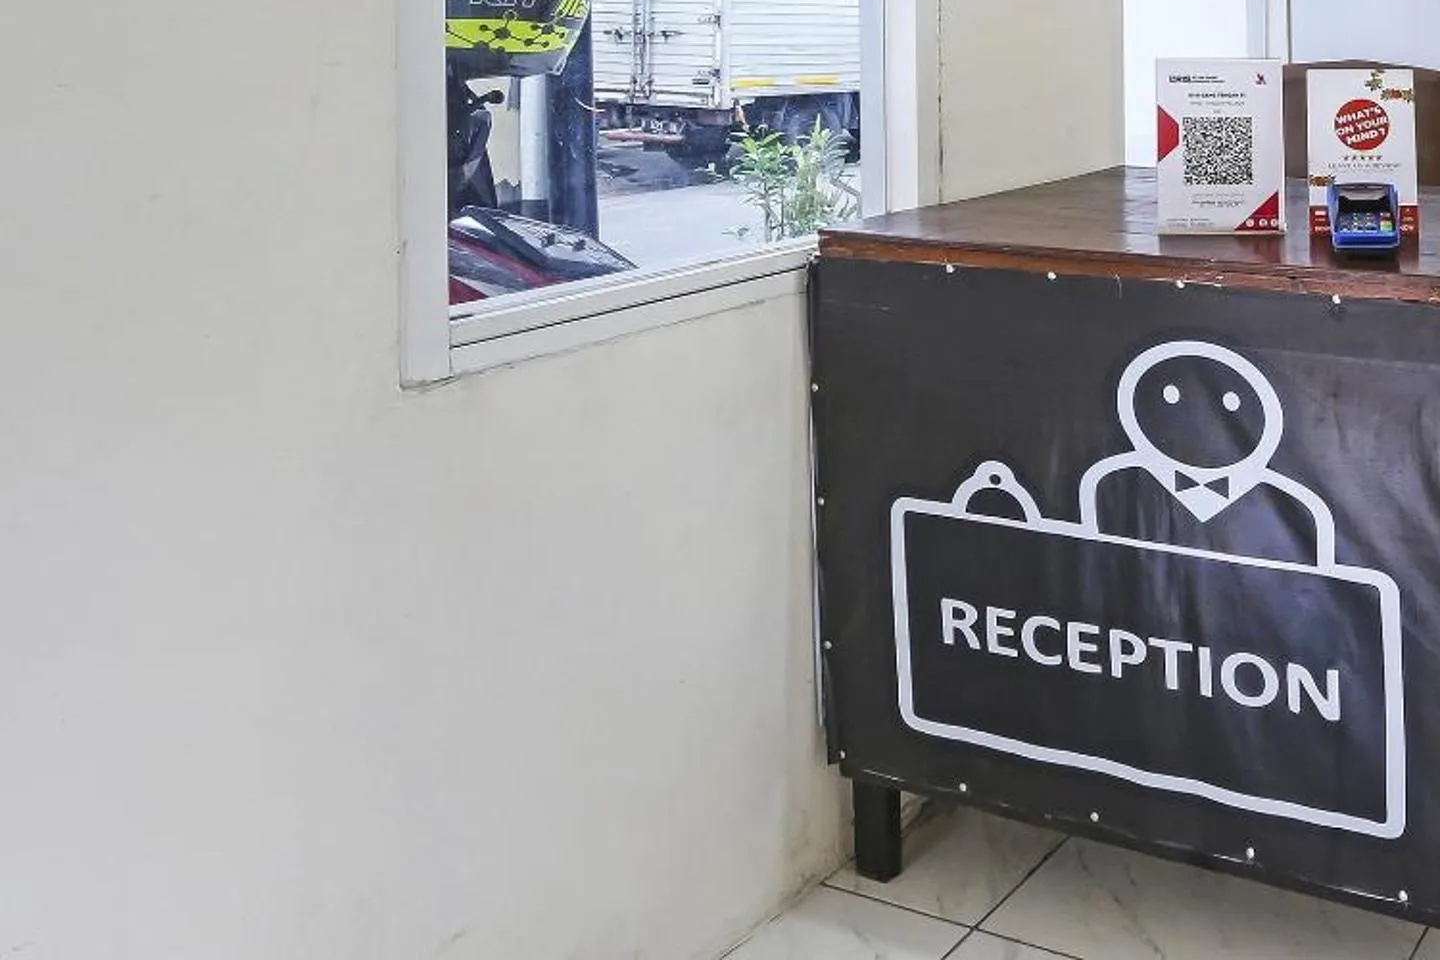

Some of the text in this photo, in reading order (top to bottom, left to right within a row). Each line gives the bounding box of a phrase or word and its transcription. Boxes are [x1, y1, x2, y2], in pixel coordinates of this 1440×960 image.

[1336, 106, 1382, 124] WHAT'S
[1336, 116, 1389, 137] ON YOUR
[939, 597, 1342, 722] RECEPTION
